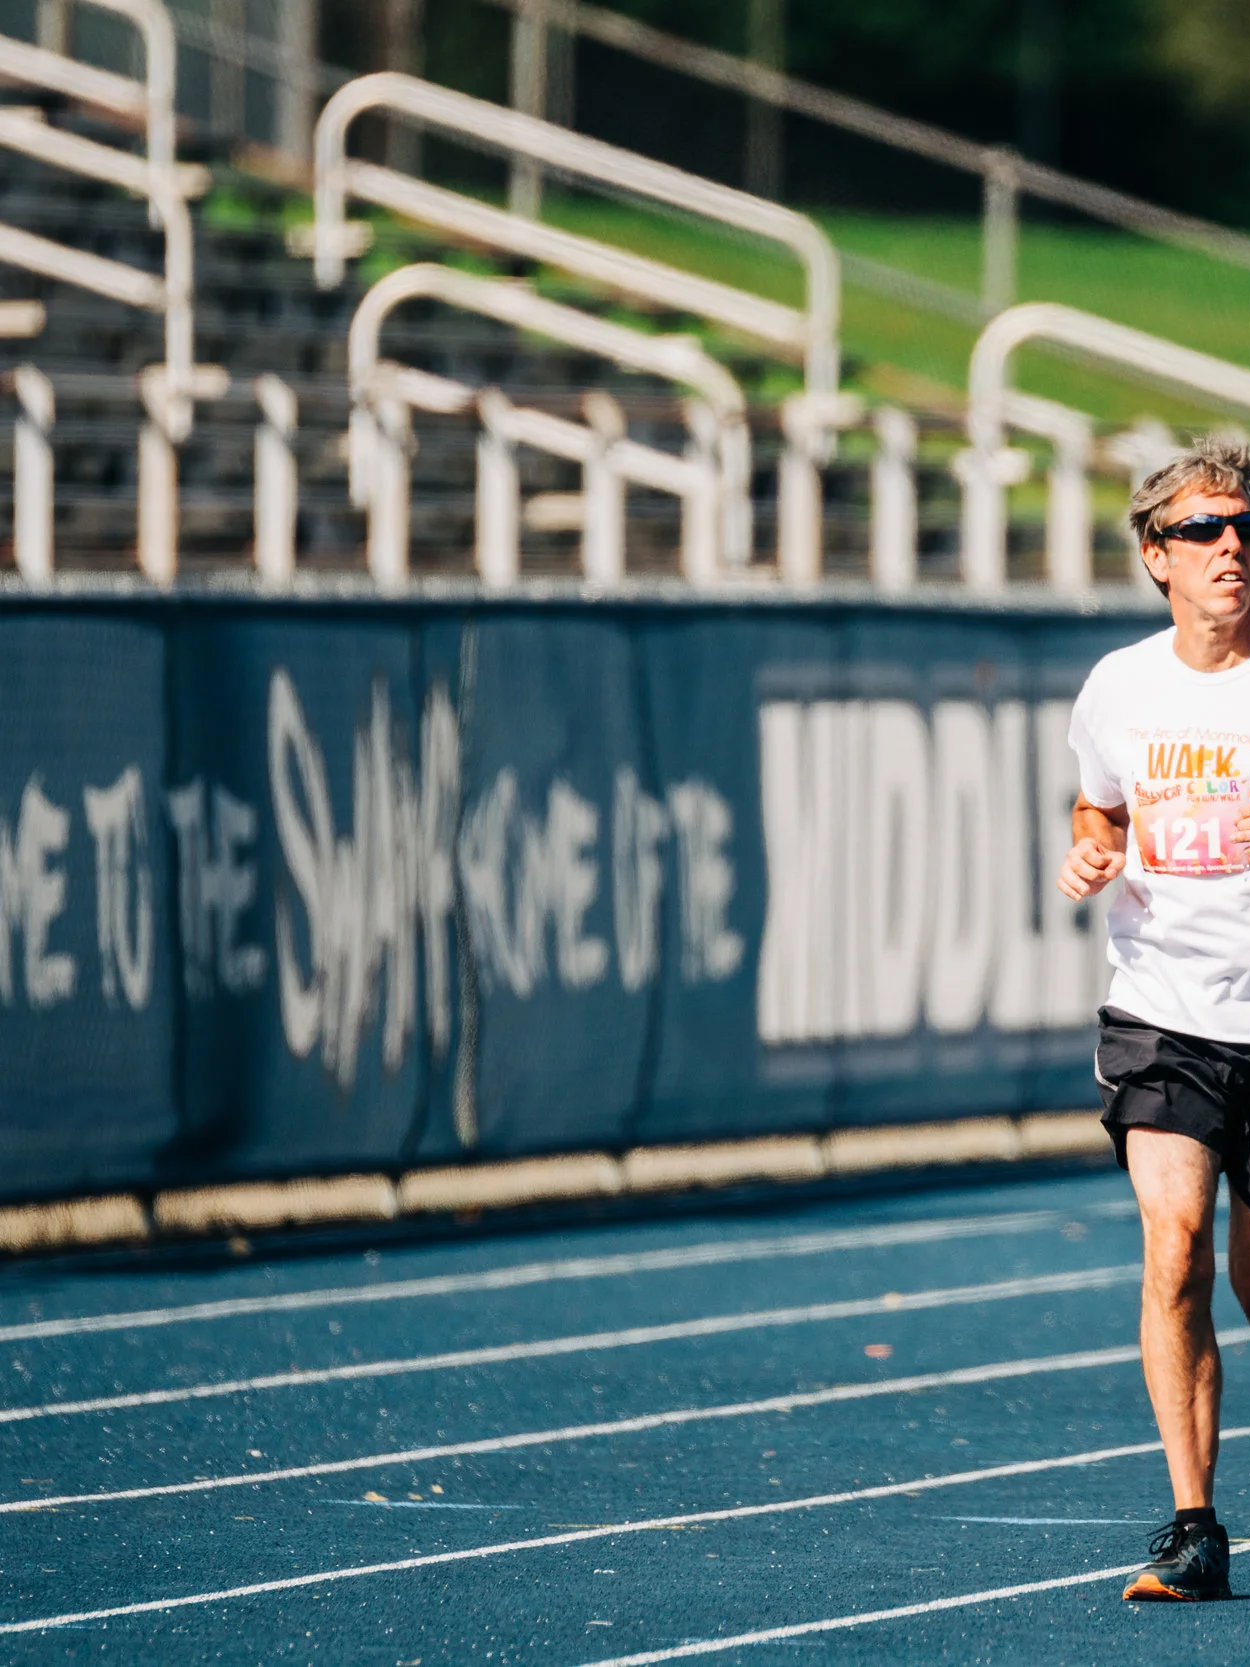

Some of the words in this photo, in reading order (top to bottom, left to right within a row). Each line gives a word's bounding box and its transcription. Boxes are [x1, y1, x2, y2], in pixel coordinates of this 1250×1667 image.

[1127, 727, 1150, 741] The
[1153, 725, 1174, 740] Arc
[1176, 724, 1192, 740] of
[1186, 780, 1240, 794] COLOR
[1149, 817, 1222, 861] 121
